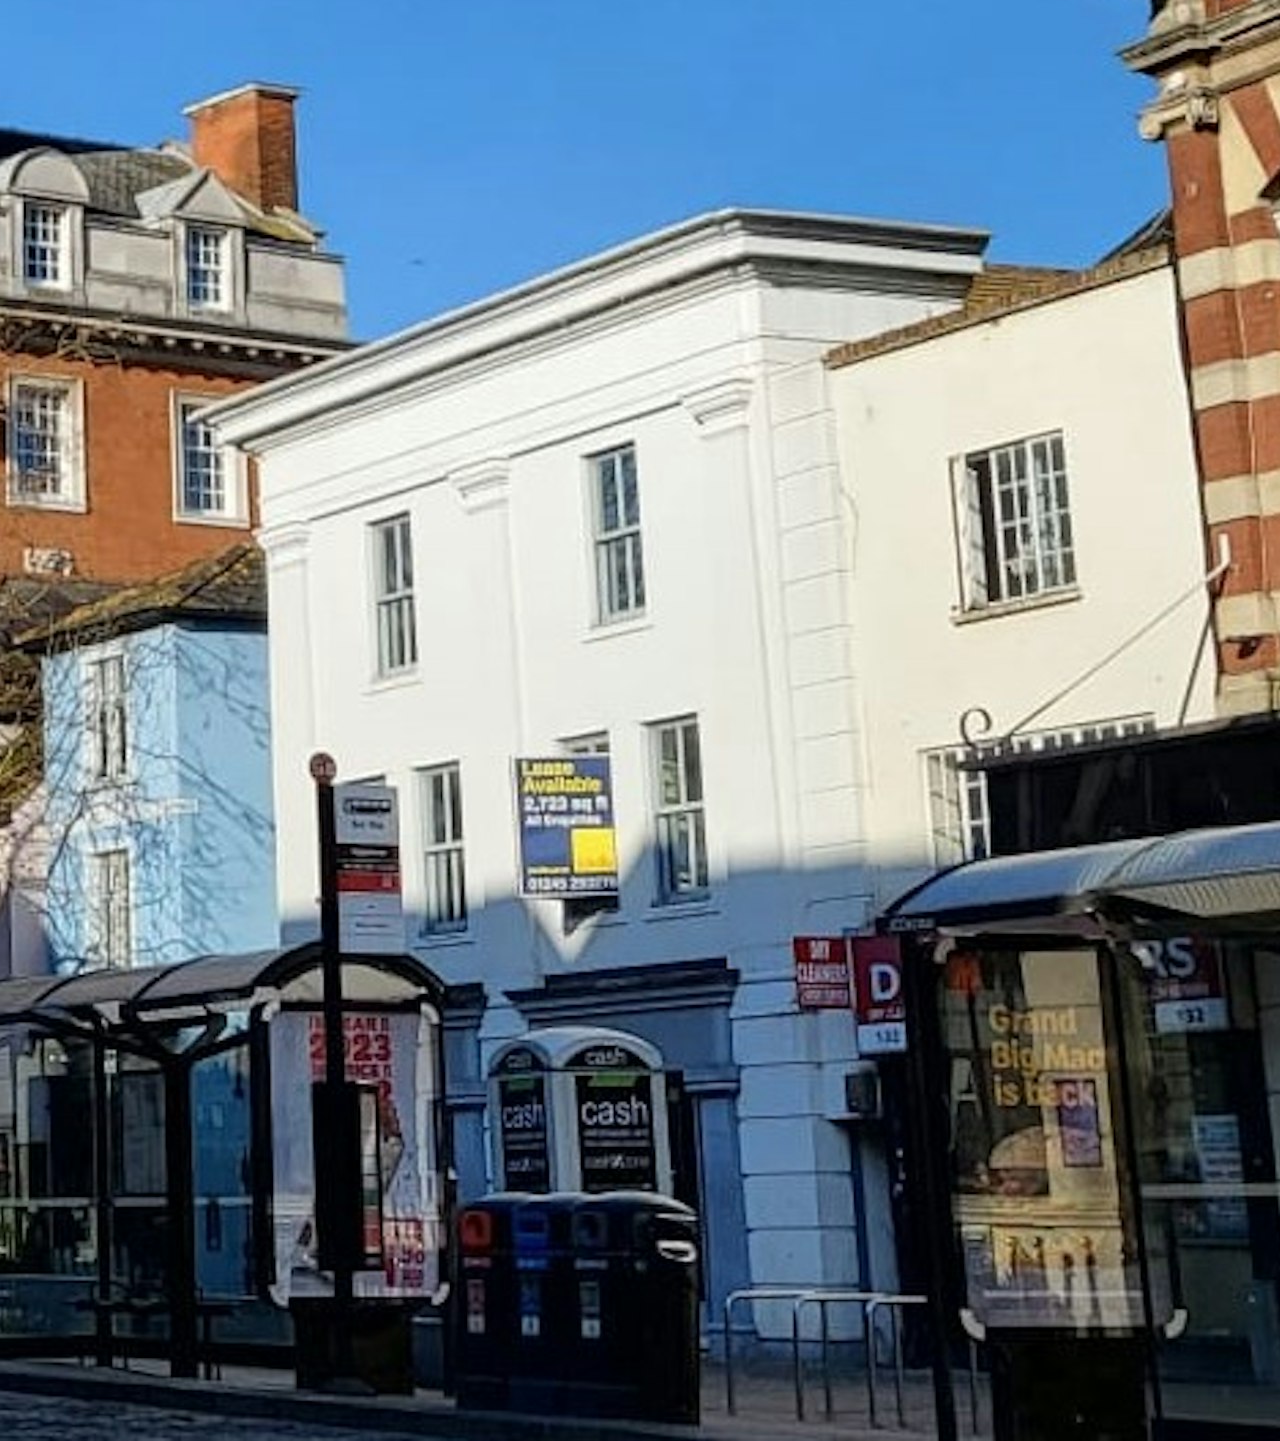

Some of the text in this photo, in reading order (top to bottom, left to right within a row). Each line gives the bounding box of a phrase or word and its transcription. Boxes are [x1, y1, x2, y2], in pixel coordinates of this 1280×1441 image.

[522, 760, 575, 776] Lease
[523, 776, 602, 794] Available
[988, 1003, 1077, 1036] Grand
[583, 1046, 628, 1066] cash
[990, 1040, 1108, 1077] Big Mac
[994, 1073, 1097, 1107] is back
[502, 1094, 544, 1129] cash
[580, 1092, 650, 1127] cash
